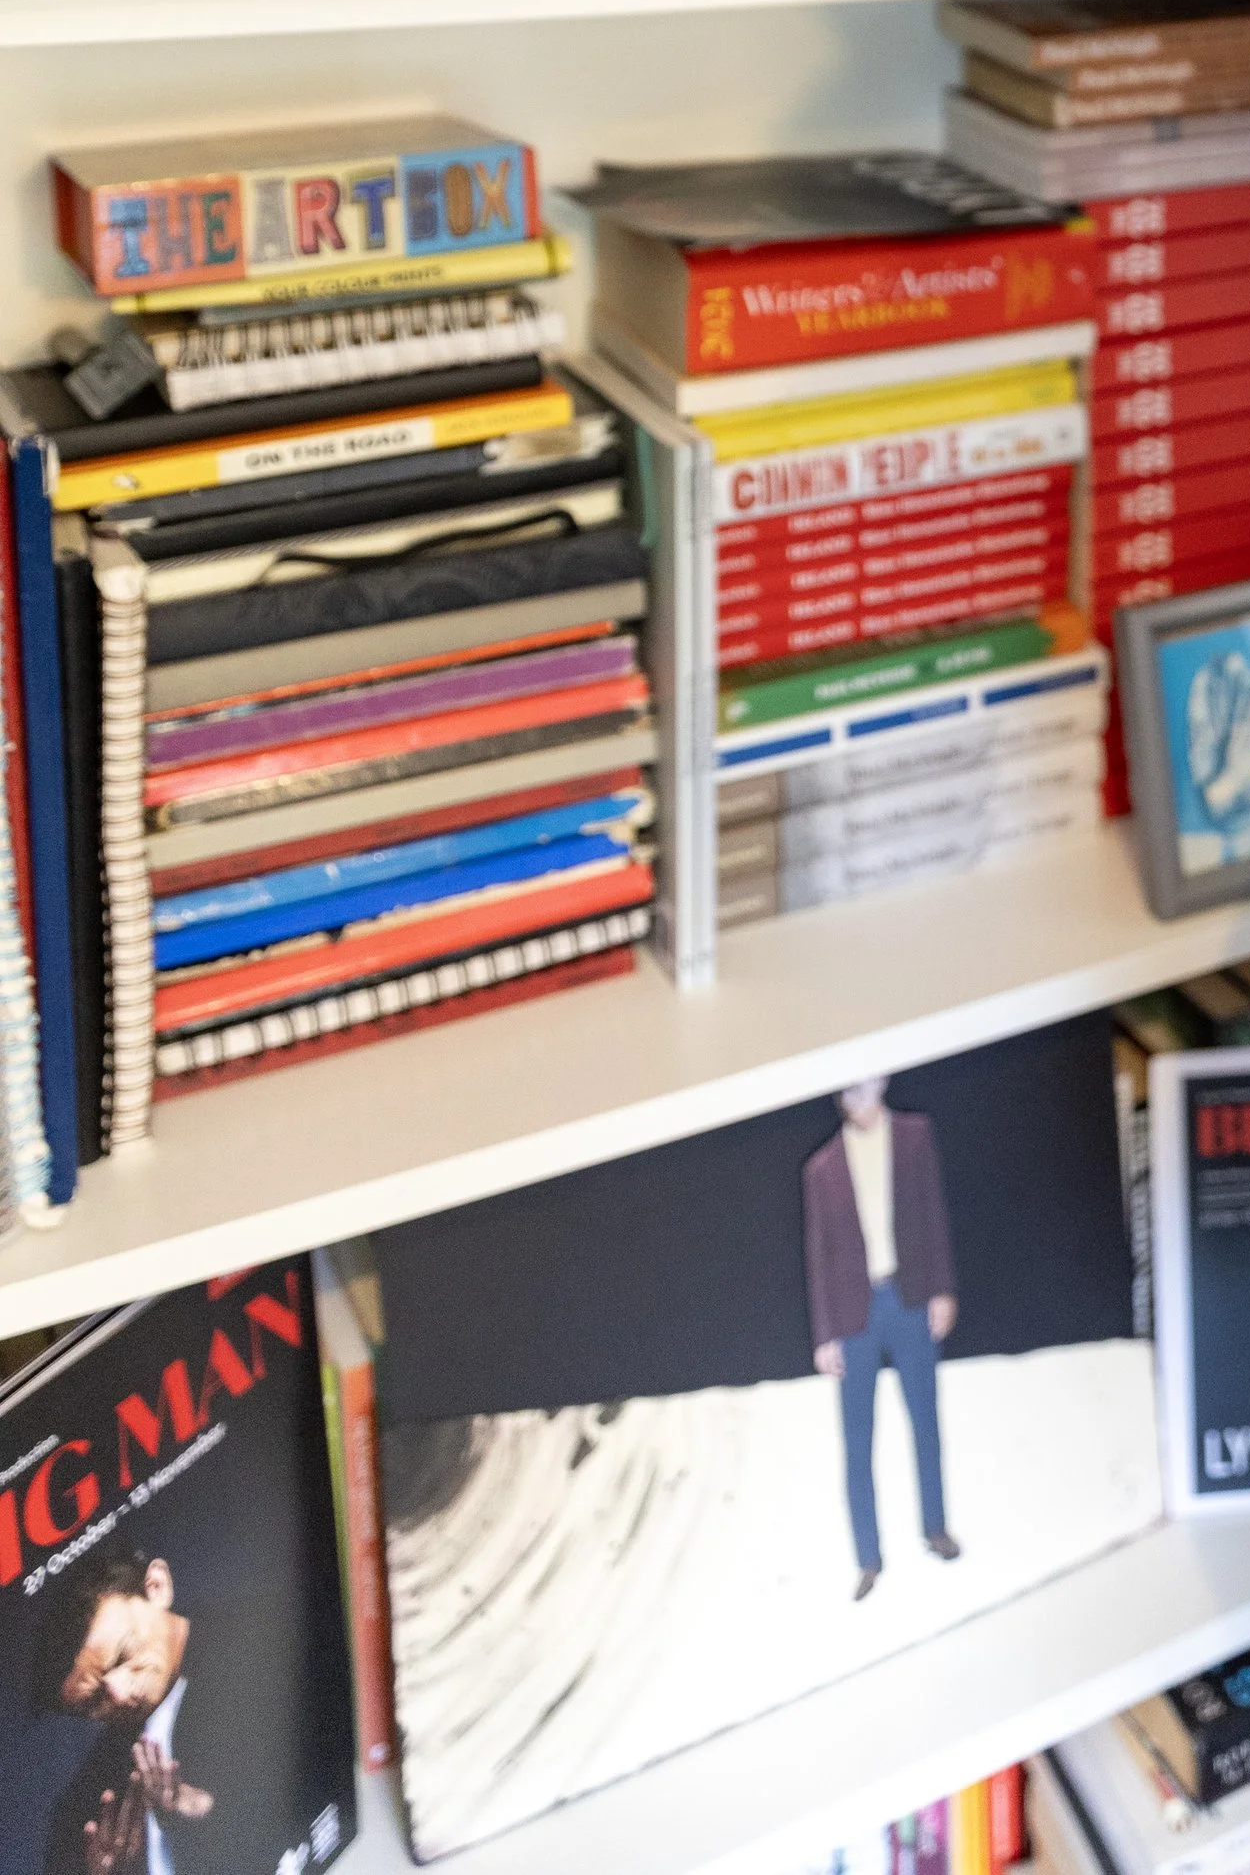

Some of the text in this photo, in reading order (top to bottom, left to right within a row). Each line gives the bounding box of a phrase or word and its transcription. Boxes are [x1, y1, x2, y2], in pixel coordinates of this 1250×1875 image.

[106, 157, 514, 279] THE ART BOX
[245, 428, 411, 471] ON THE ROAD
[114, 1269, 303, 1490] MAN
[23, 1565, 47, 1597] 27
